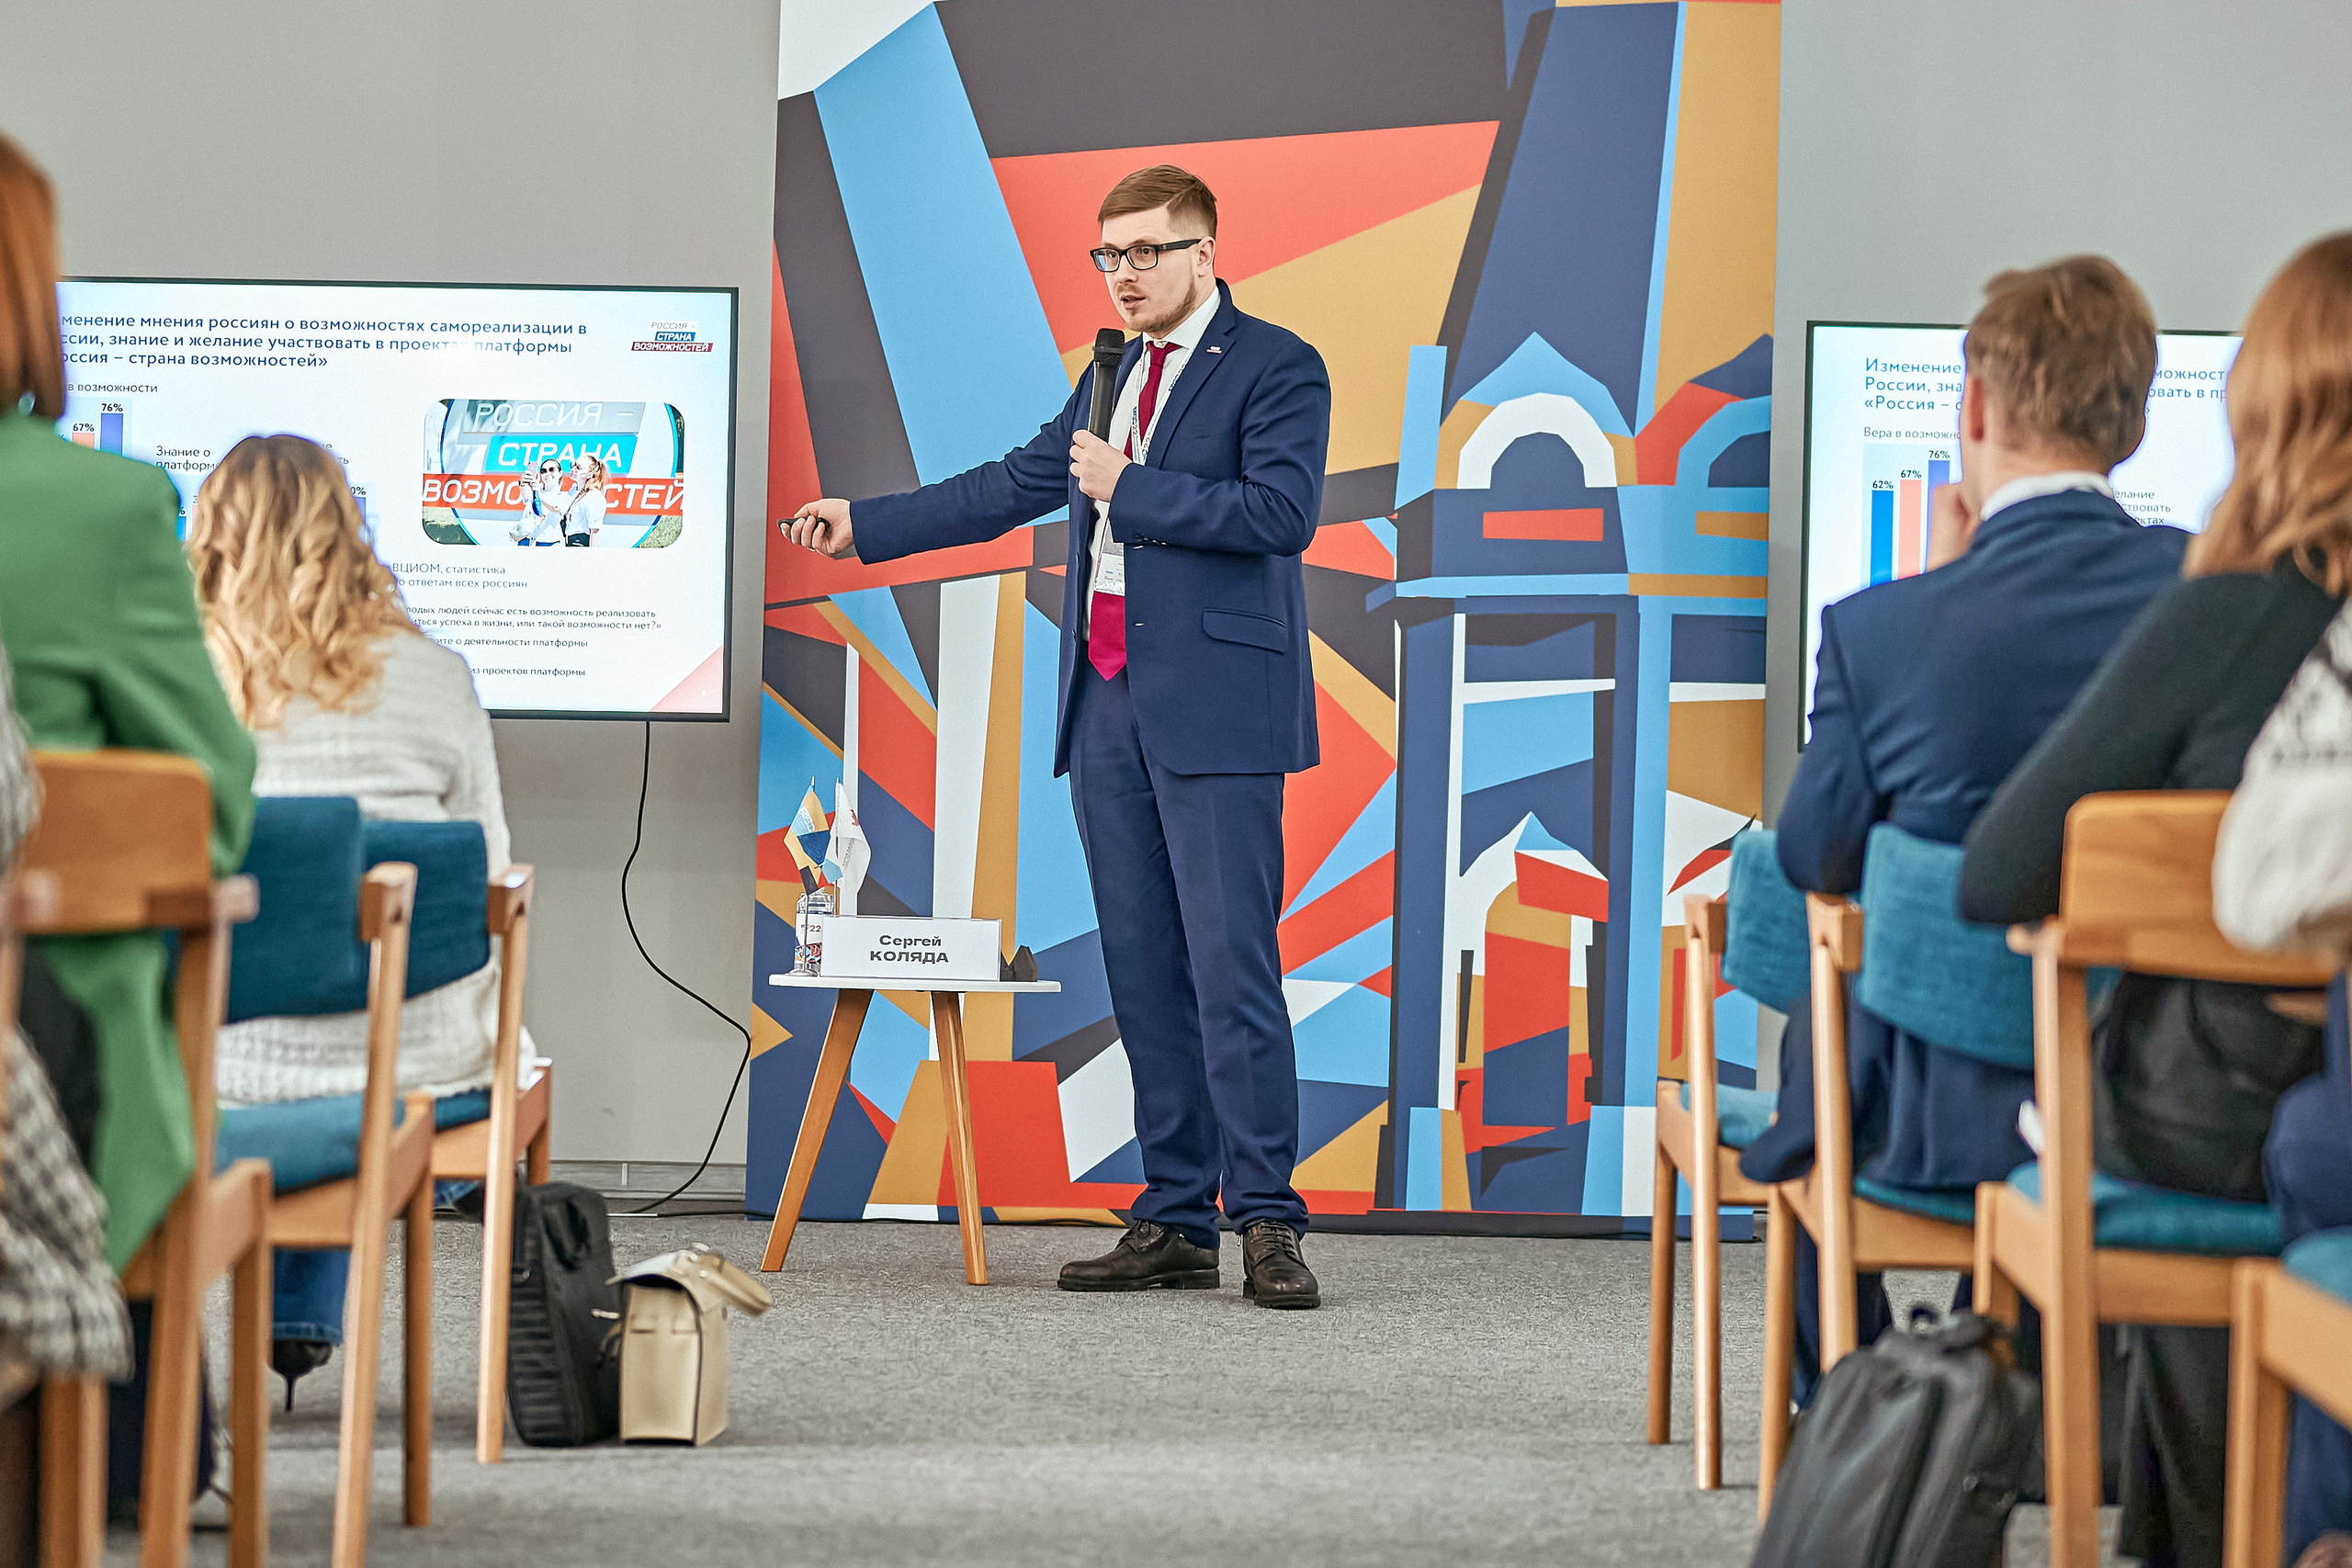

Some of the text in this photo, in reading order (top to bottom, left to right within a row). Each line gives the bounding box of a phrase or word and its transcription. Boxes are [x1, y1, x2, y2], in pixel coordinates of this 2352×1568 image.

[62, 316, 587, 335] менение мнения россиян о возможностях самореализации в
[656, 333, 692, 341] СТРАНА
[61, 334, 104, 346] ссии,
[108, 335, 169, 346] знание
[175, 336, 184, 345] и
[189, 336, 263, 347] желание
[268, 337, 370, 351] участвовать
[377, 340, 384, 349] в
[474, 338, 571, 355] платформы
[634, 342, 709, 351] ВОЗМОЖНОСТЕЙ
[62, 353, 108, 364] оссия
[129, 354, 186, 367] страна
[191, 354, 328, 367] возможностей»
[1866, 358, 1962, 374] Изменение
[77, 384, 158, 393] возможности
[1865, 377, 1931, 393] России,
[2197, 389, 2205, 398] в
[101, 403, 123, 412] 76%
[1865, 395, 1935, 410] «Россия
[474, 402, 603, 427] РОССИЯ
[73, 423, 95, 432] 67%
[1864, 426, 1892, 439] Вера
[156, 446, 210, 457] Знание о
[1929, 450, 1950, 459] 76%
[1900, 470, 1922, 479] 67%
[1872, 480, 1894, 489] 62%
[351, 487, 366, 495] 0%
[423, 479, 684, 511] ВОЗМОСТЕЙ
[2115, 491, 2155, 499] елание
[392, 562, 443, 573] ВЦИОМ,
[408, 579, 452, 587] ответам
[482, 581, 527, 589] россиян
[437, 606, 469, 615] людей
[472, 606, 504, 615] сейчас
[595, 610, 656, 618] реализовать
[439, 619, 472, 627] успеха
[537, 620, 564, 628] такой
[568, 621, 632, 629] возможности
[533, 638, 588, 648] платформы
[531, 668, 586, 677] платформы
[879, 935, 942, 948] Сергей
[870, 951, 949, 964] КОЛЯДА
